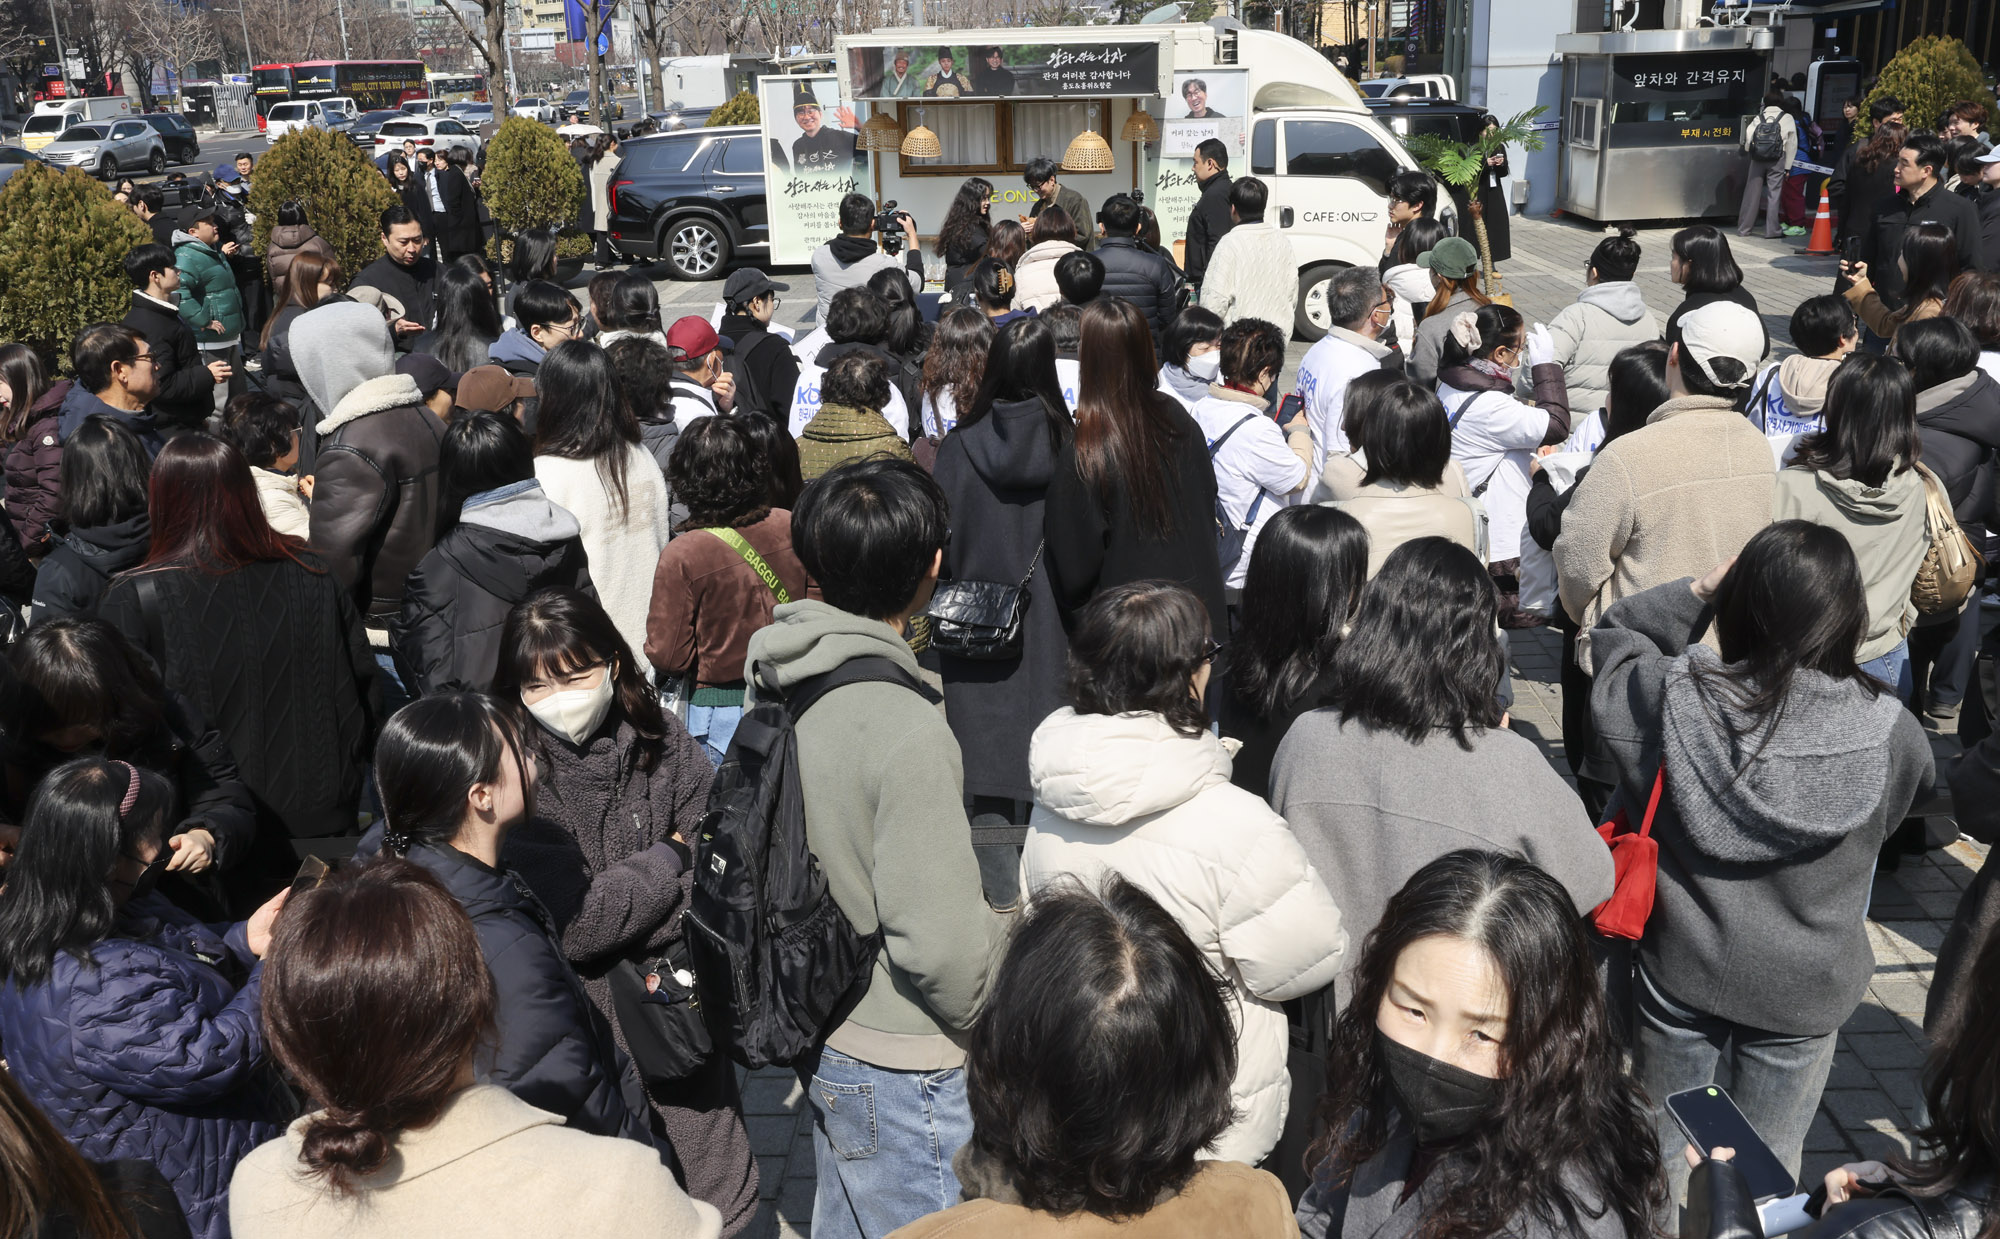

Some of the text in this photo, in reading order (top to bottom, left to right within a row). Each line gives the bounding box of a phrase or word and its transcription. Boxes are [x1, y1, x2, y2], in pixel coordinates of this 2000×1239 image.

[1046, 47, 1127, 69] 왕과 사는 남자
[1042, 70, 1132, 81] 관객 여러분 감사합니다
[1634, 69, 1745, 88] 앞차와 간격유지
[351, 81, 367, 91] SEOUL
[367, 81, 379, 91] CITY
[379, 81, 392, 90] TOUR
[392, 80, 401, 90] BUS
[1171, 129, 1184, 137] 커피
[1681, 127, 1732, 139] 부재 시 전화
[1155, 169, 1183, 191] 왕과
[784, 176, 859, 198] 왕과 사는 남자
[788, 202, 826, 211] 사랑해주시는
[1167, 205, 1186, 213] 감사의
[797, 212, 816, 220] 감사의
[1303, 211, 1360, 222] CAFE:ON
[743, 548, 779, 589] BAGGU
